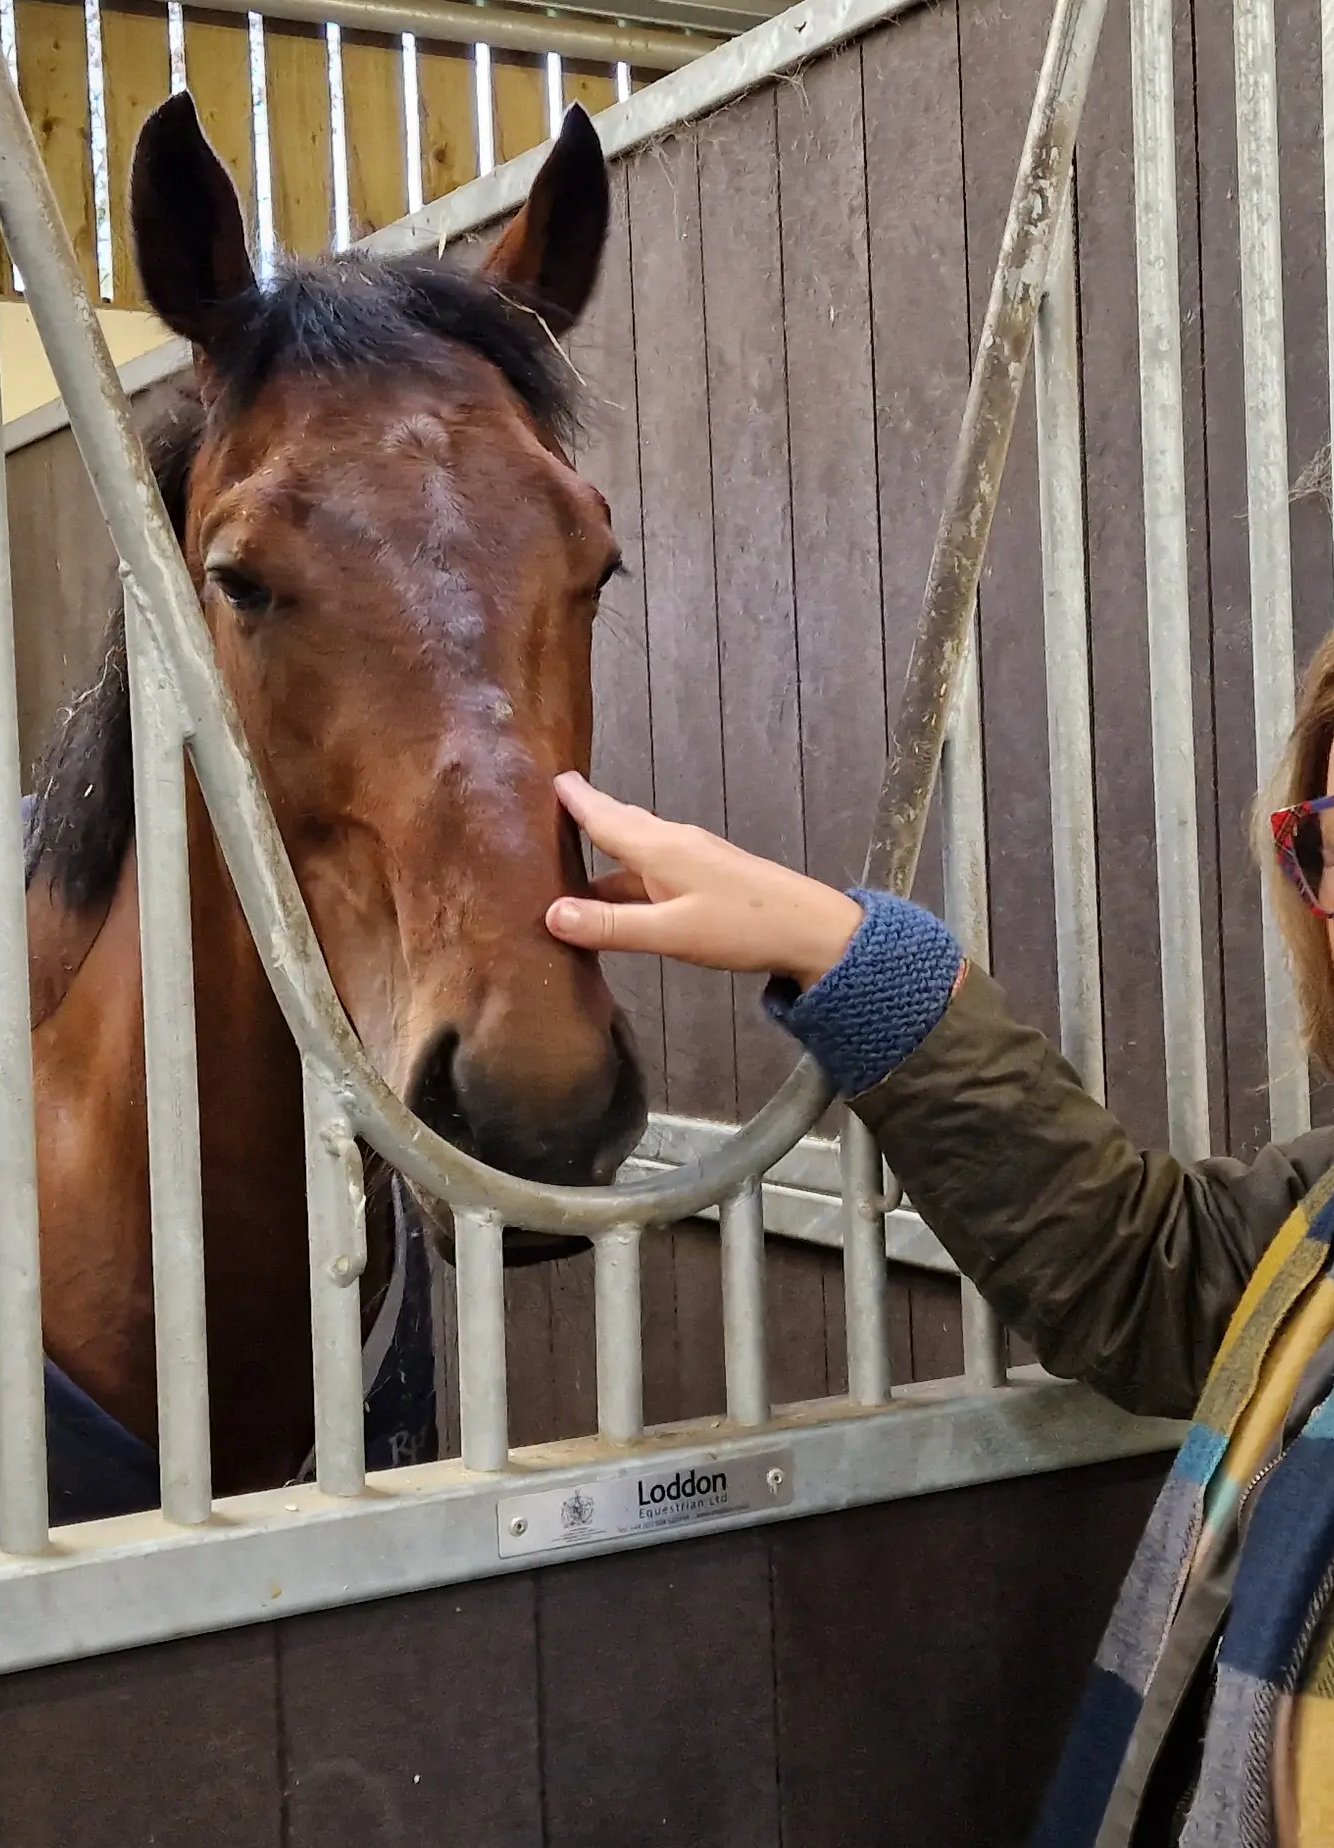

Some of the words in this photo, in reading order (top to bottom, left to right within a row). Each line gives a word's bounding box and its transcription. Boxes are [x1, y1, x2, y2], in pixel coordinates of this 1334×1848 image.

[638, 1469, 727, 1506] Loddon
[638, 1498, 705, 1519] Equestrian
[709, 1494, 728, 1506] Ltd
